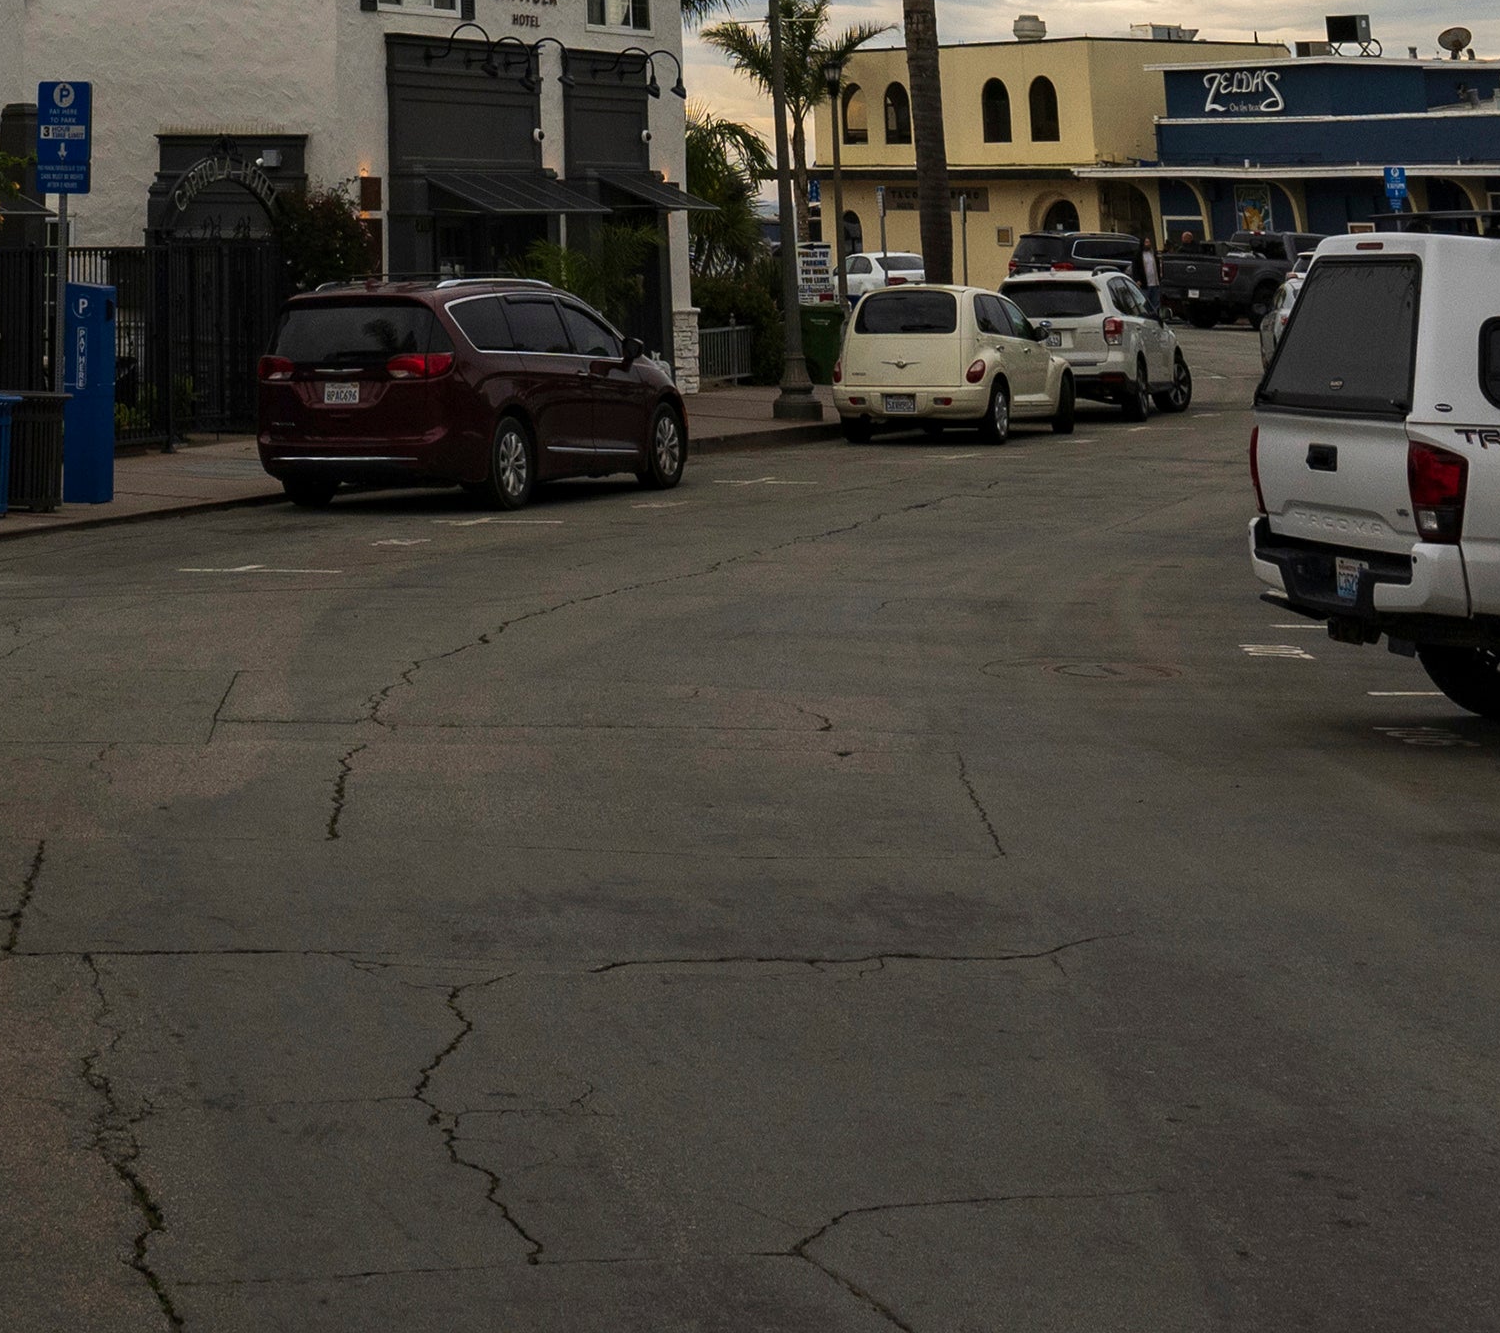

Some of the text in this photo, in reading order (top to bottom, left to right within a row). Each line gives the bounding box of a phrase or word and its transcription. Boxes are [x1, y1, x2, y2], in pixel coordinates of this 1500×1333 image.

[512, 14, 540, 28] HOTEL
[1203, 69, 1285, 112] ZELDA'S
[49, 108, 78, 116] PAY HERE
[43, 126, 50, 138] 3
[174, 156, 277, 212] CAPITOLA HOTEL
[1294, 511, 1384, 537] TACOMA
